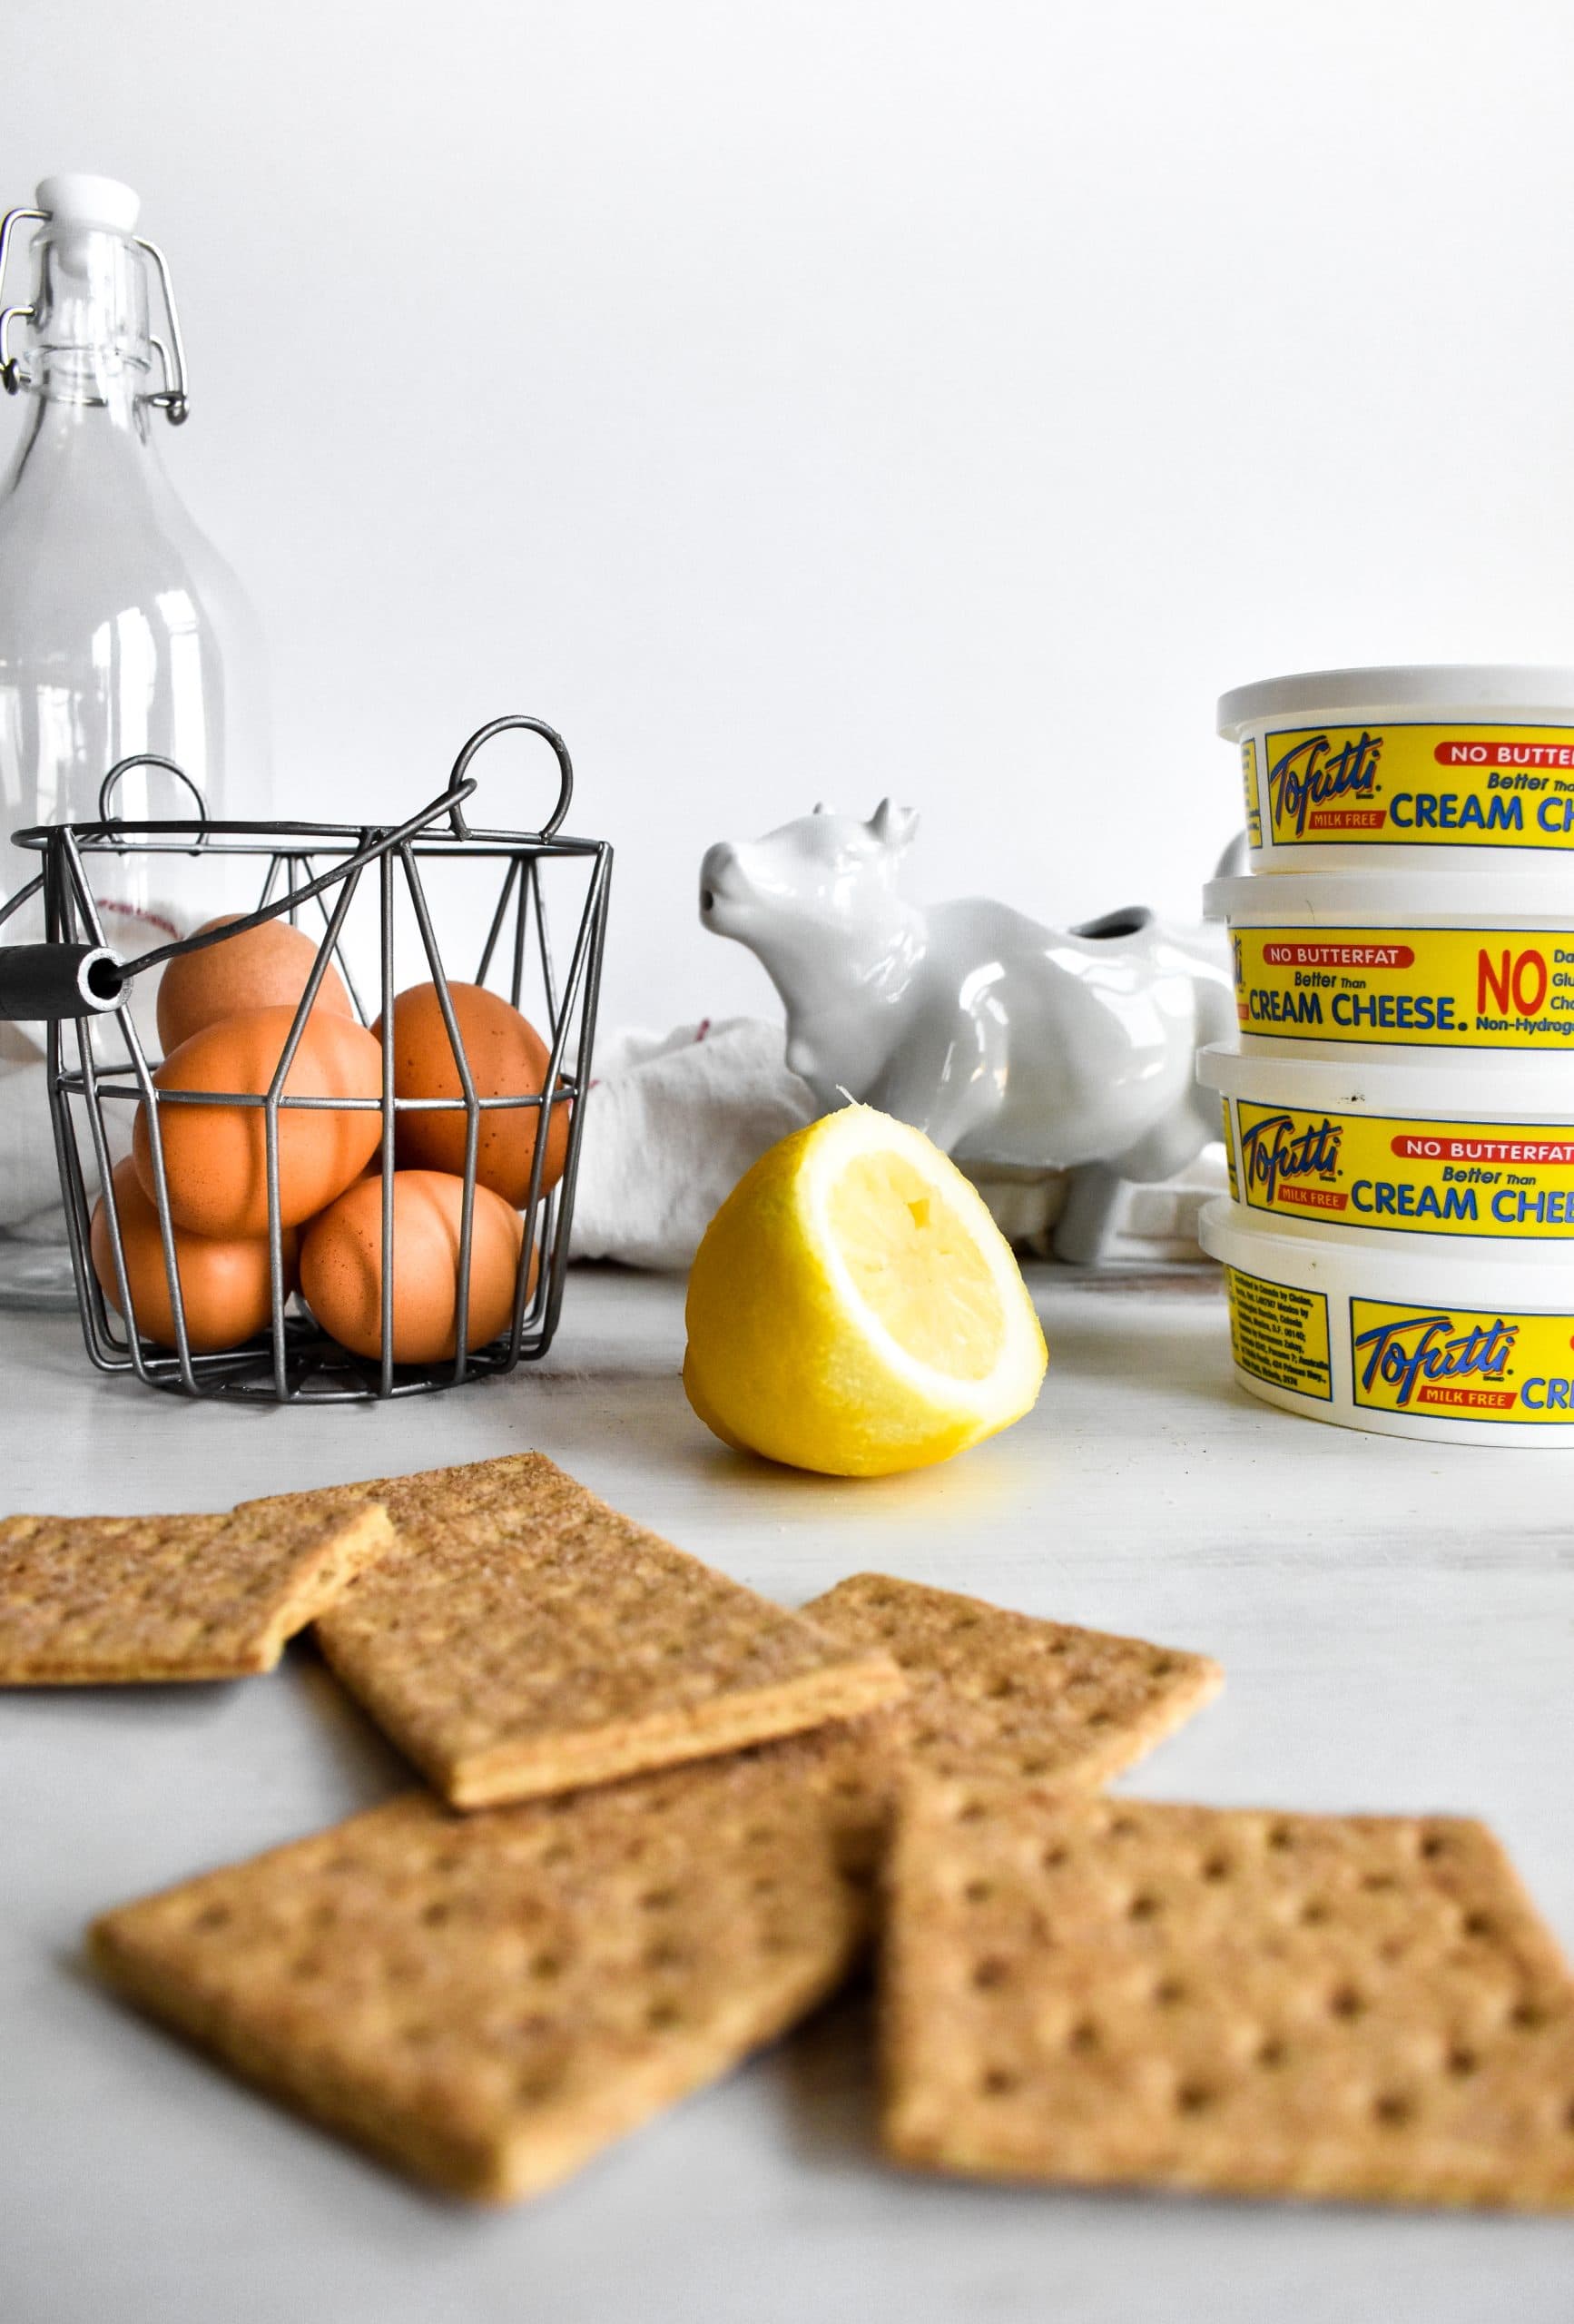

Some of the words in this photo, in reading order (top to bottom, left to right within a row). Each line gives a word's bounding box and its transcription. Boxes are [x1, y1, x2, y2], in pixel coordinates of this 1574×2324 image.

[1451, 745, 1487, 763] NO
[1497, 746, 1574, 765] BUTTE
[1487, 772, 1549, 791] Better
[1313, 813, 1341, 827] MILK
[1345, 813, 1378, 827] FREE
[1390, 793, 1524, 831] CREAM
[1271, 948, 1292, 963] NO
[1297, 948, 1399, 965] BUTTERFAT
[1294, 970, 1337, 989] Better
[1341, 977, 1367, 990] Than
[1477, 949, 1548, 1017] NO
[1249, 989, 1323, 1025] CREAM
[1475, 1016, 1574, 1036] Non-Hydrog
[1406, 1140, 1441, 1157] NO
[1451, 1143, 1574, 1161] BUTTERFAT
[1441, 1166, 1502, 1185] Better
[1507, 1174, 1537, 1186] Than
[1282, 1187, 1308, 1203] MILK
[1310, 1192, 1342, 1207] FREE
[1351, 1179, 1479, 1221] CREAM
[1426, 1388, 1464, 1405] MILK
[1468, 1393, 1508, 1407] FREE
[1520, 1377, 1574, 1410] CR
